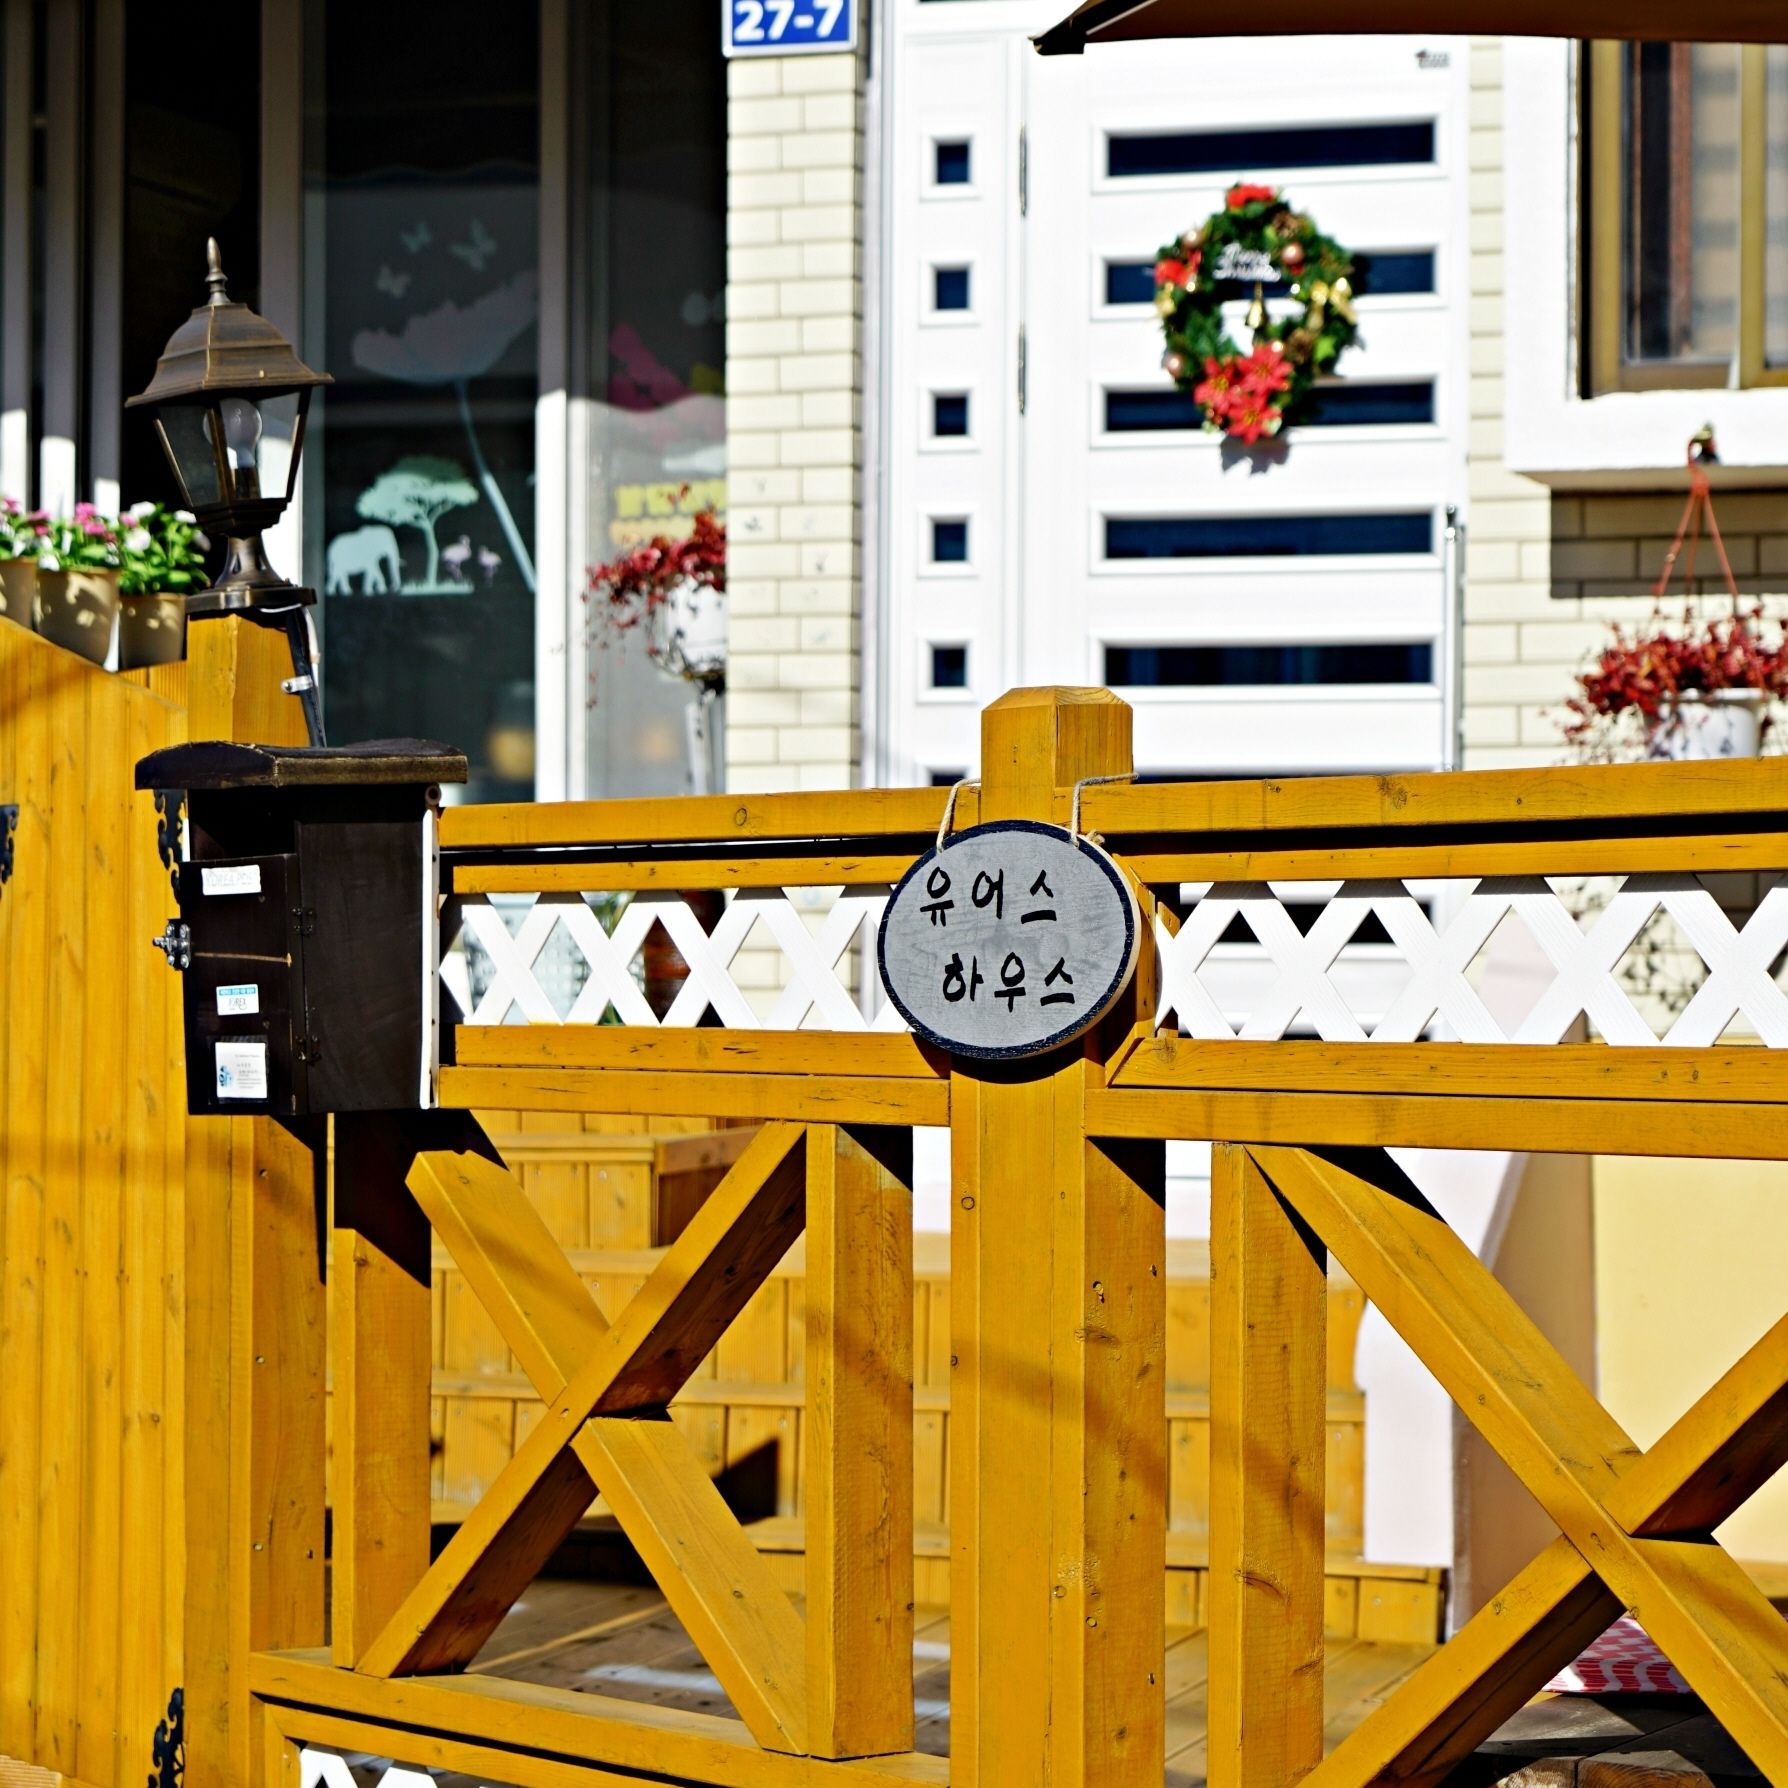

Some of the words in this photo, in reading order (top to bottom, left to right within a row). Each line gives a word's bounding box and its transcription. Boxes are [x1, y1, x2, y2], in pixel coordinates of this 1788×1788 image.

[734, 0, 844, 42] 27-7
[919, 866, 1057, 927] 유어스
[942, 951, 1076, 1013] 하우스
